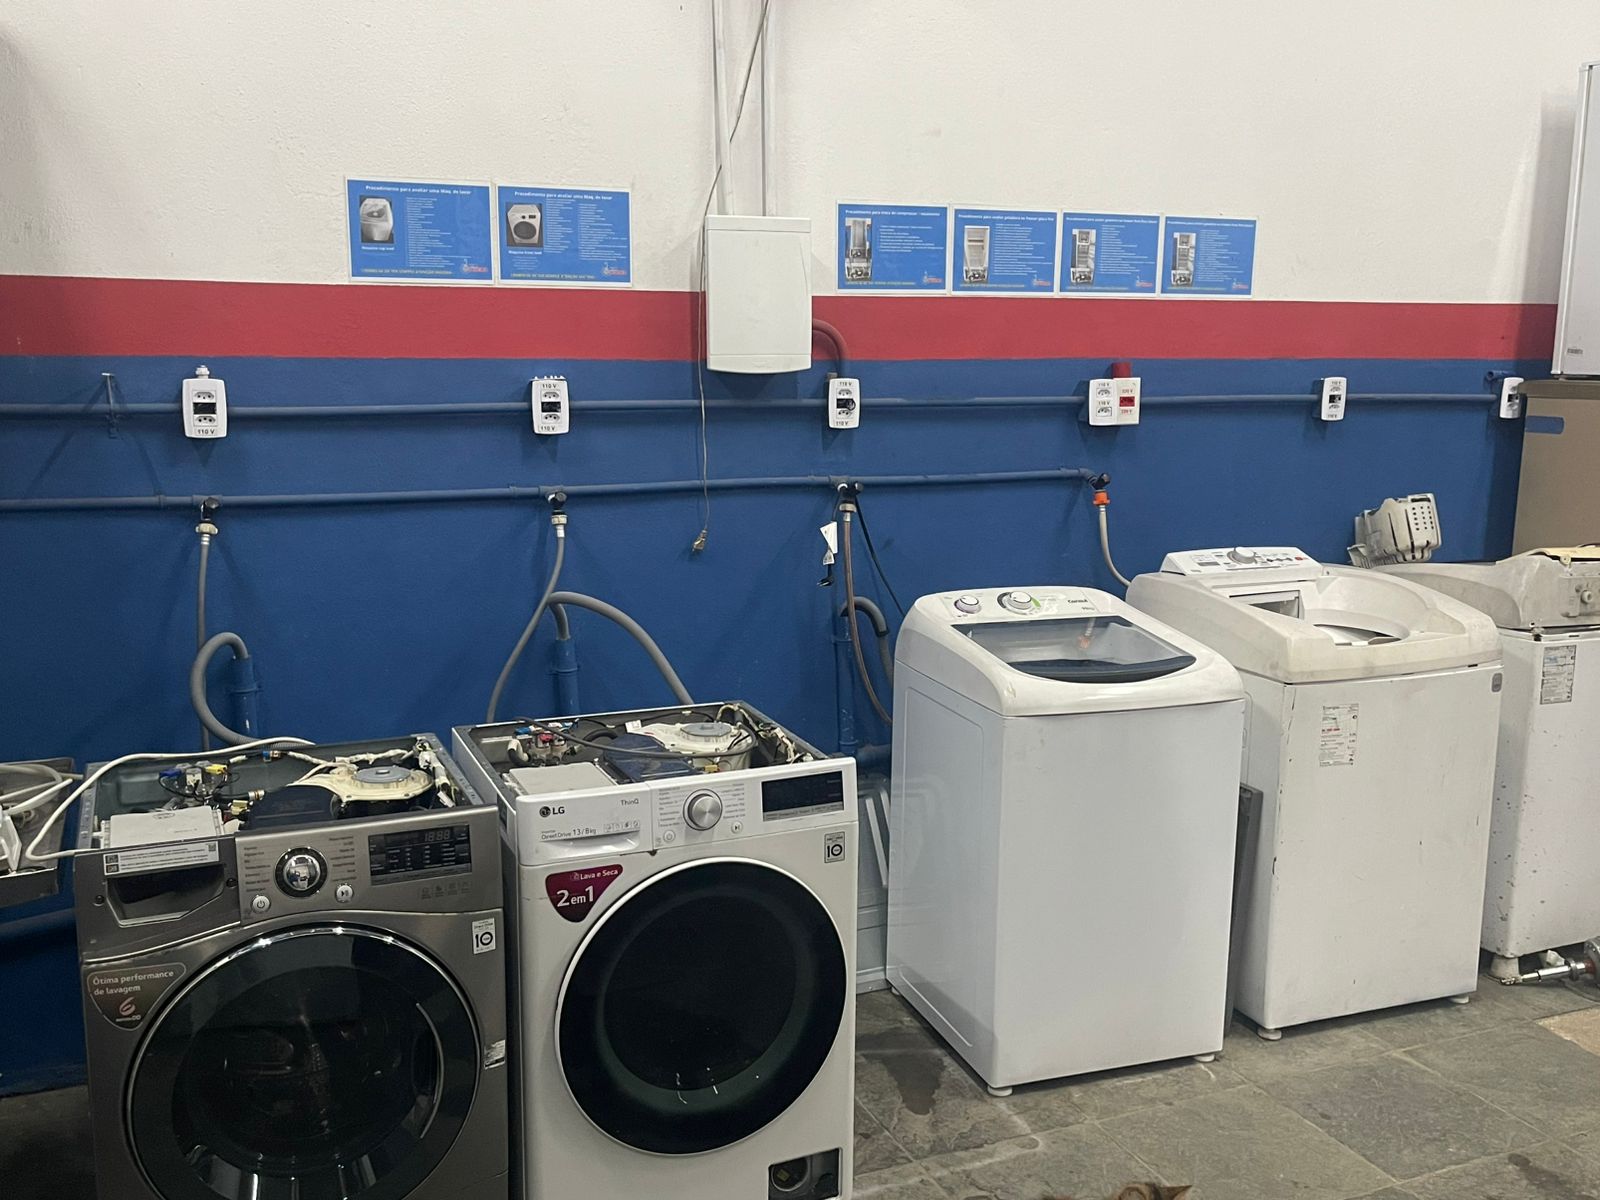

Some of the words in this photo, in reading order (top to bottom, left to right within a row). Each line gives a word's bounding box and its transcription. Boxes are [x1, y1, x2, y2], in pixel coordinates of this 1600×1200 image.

[621, 798, 640, 806] ThinQ
[552, 806, 565, 815] LG
[602, 869, 619, 877] Seca
[556, 889, 570, 907] 2
[570, 895, 586, 905] em
[585, 885, 594, 902] 1
[120, 970, 174, 984] performance
[94, 988, 105, 996] de
[106, 984, 141, 995] lavagem
